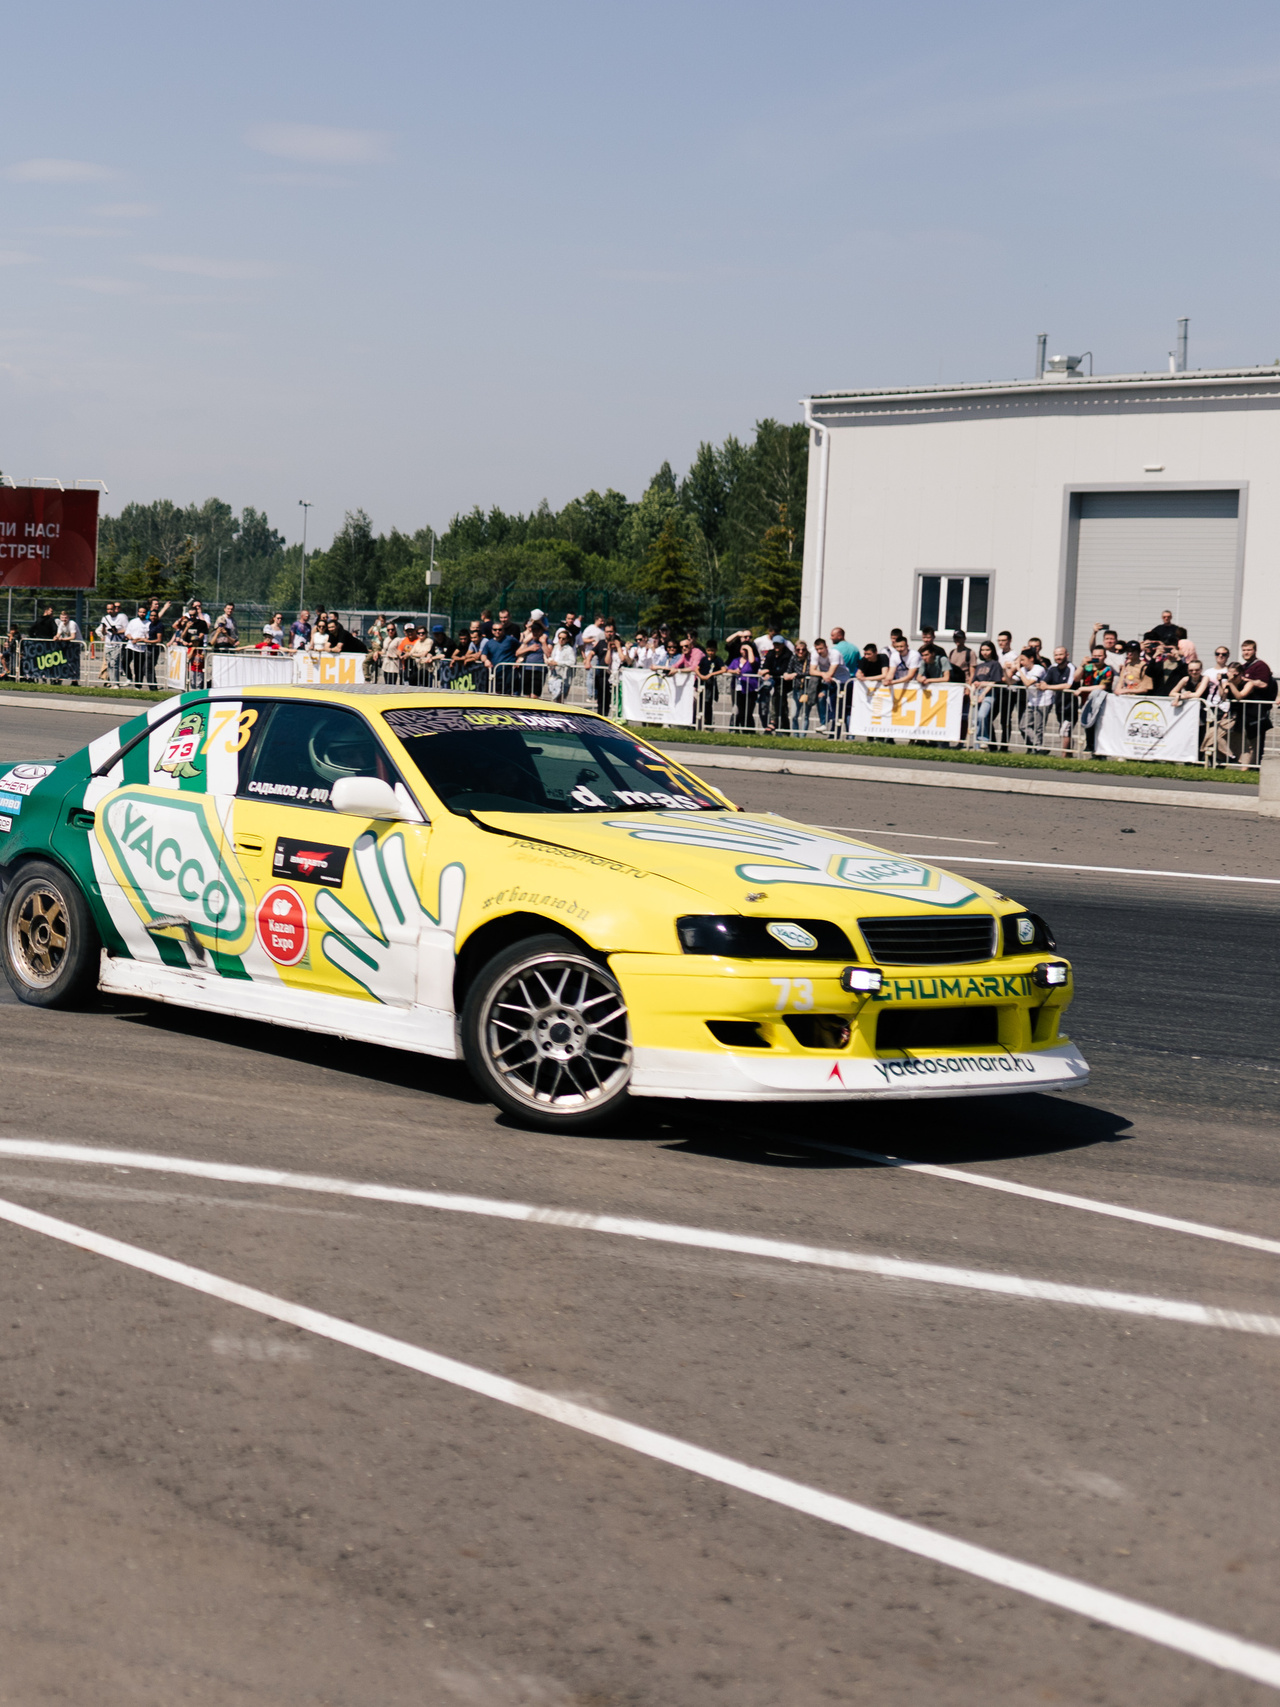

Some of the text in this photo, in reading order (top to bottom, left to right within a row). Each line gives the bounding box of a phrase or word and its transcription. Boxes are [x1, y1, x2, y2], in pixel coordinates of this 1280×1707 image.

[24, 523, 60, 538] НАС!
[37, 650, 67, 670] UGOL
[200, 709, 259, 755] 73
[168, 742, 194, 759] 73
[248, 780, 298, 797] САДЫКОВ
[121, 802, 230, 923] YACCO
[508, 839, 650, 879] yaccosamara.ru
[847, 862, 921, 882] YACCO
[268, 919, 296, 935] Kazan
[775, 927, 812, 946] YACCO
[271, 935, 295, 951] Expo
[770, 977, 814, 1011] 73
[873, 1056, 1036, 1083] yaccosamara.ru
